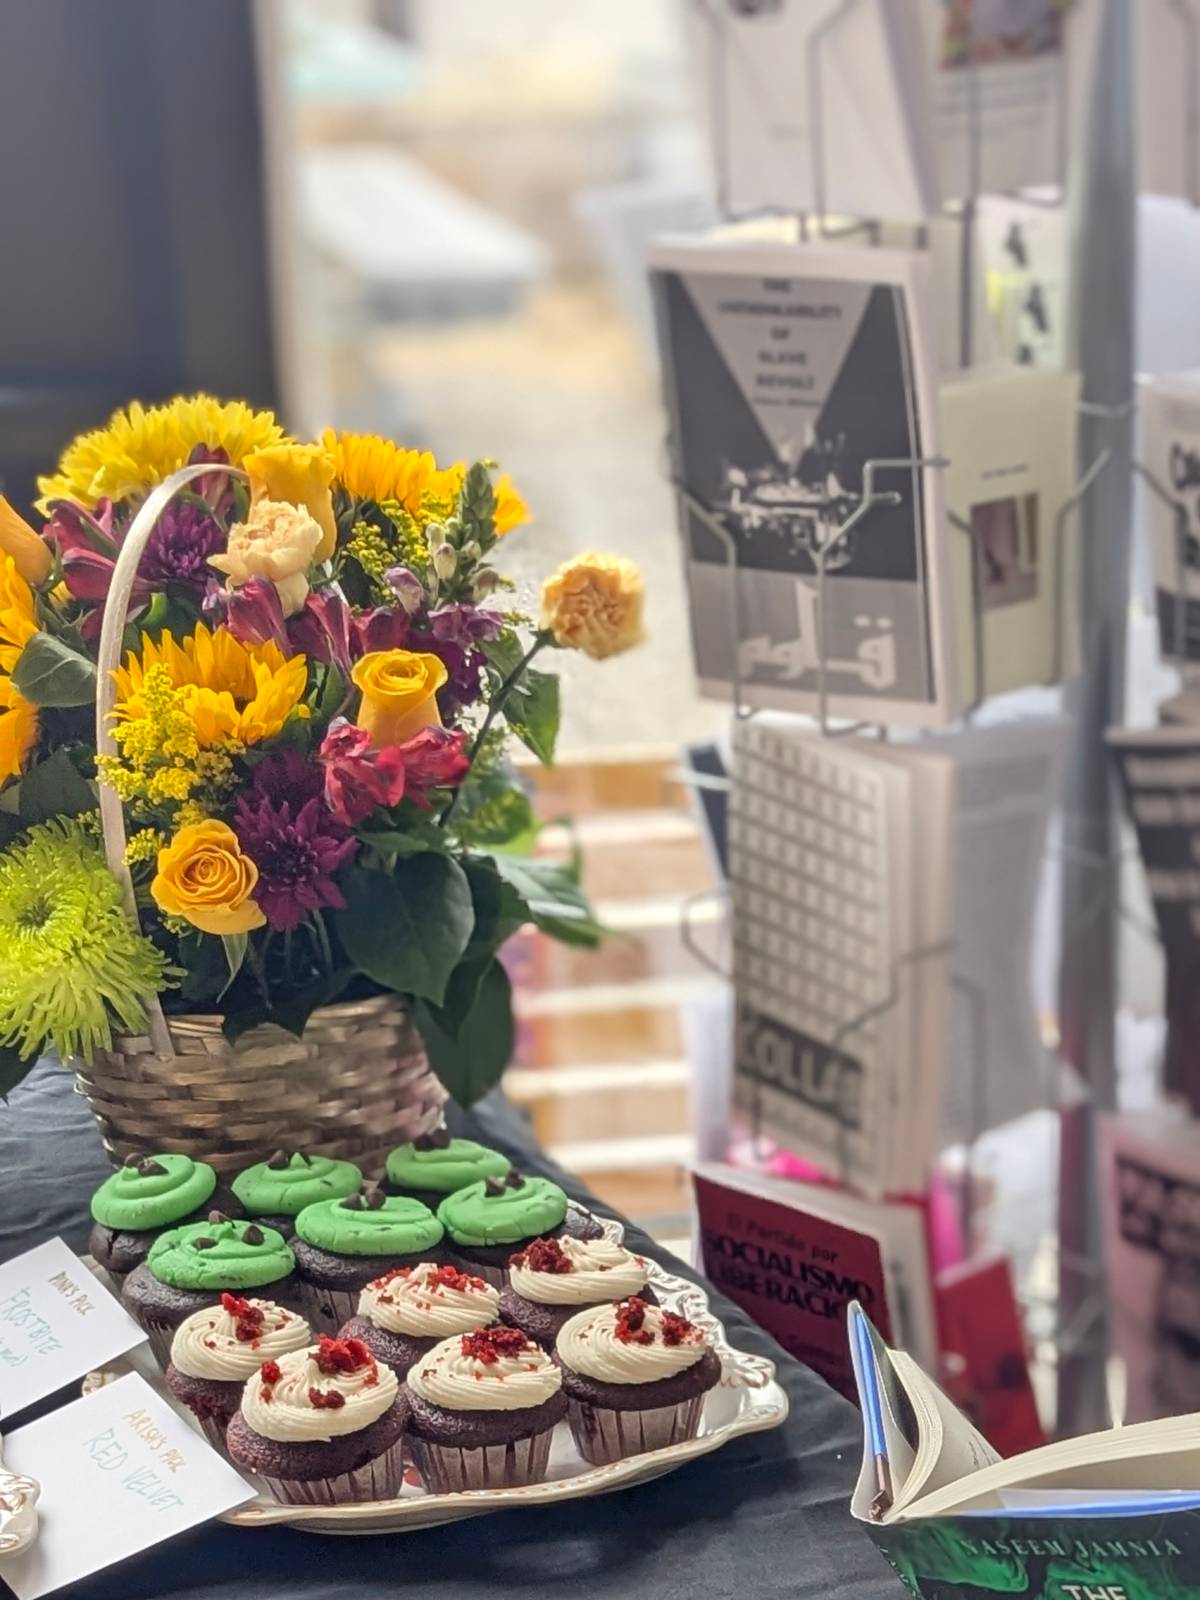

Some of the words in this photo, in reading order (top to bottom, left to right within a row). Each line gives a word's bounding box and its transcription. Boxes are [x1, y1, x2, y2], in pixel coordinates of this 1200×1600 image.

[811, 1246, 839, 1262] por
[0, 1286, 64, 1355] FROSTBITE
[961, 1537, 1063, 1557] NASEEM
[1074, 1538, 1183, 1560] JAMNIA
